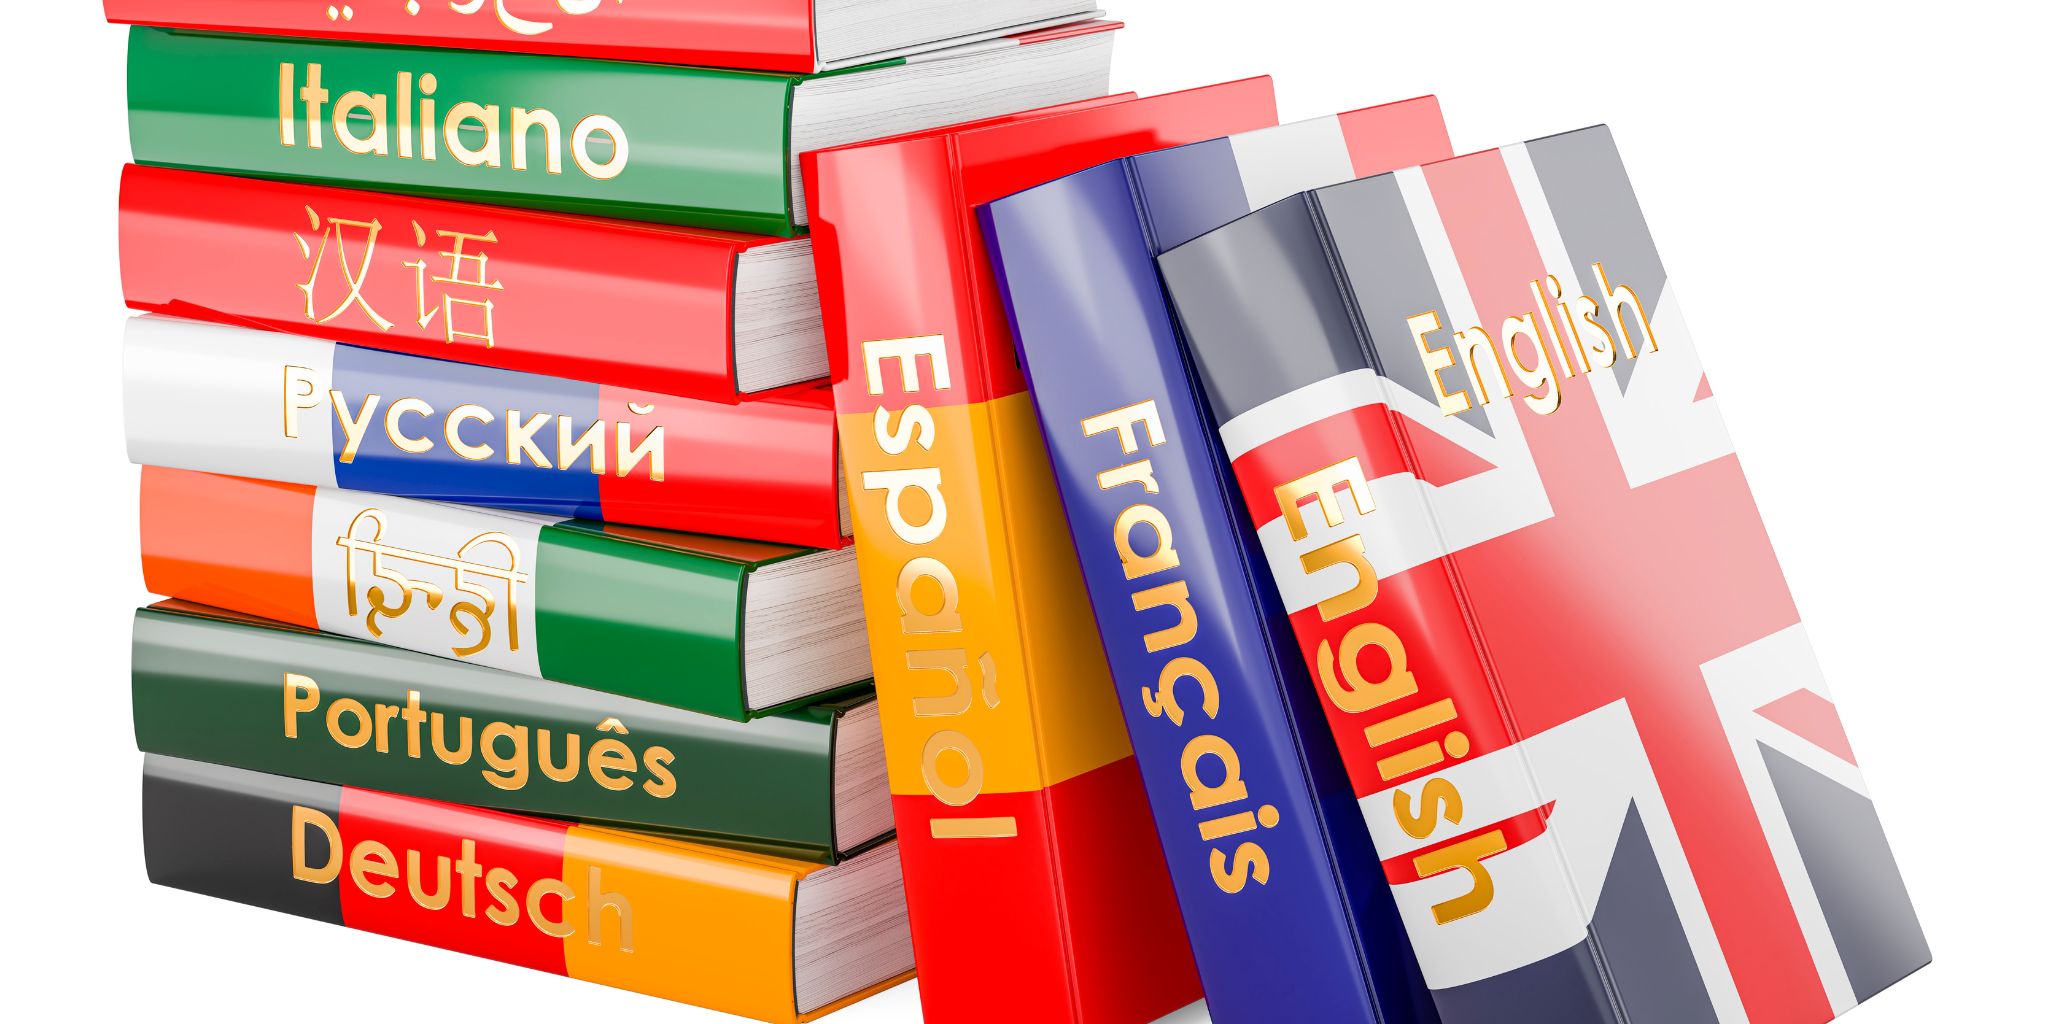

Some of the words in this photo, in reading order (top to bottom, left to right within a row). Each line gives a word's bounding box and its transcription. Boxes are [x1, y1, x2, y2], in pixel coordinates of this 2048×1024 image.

[278, 61, 630, 181] Italiano
[293, 204, 505, 350] 汉语
[1405, 262, 1660, 417] English
[282, 364, 667, 483] Русский
[336, 507, 529, 658] हिन्दी
[860, 333, 1019, 840] Español
[1079, 398, 1281, 895] Français
[282, 672, 678, 799] Português
[1273, 455, 1508, 926] English
[290, 804, 635, 953] Deutsch
